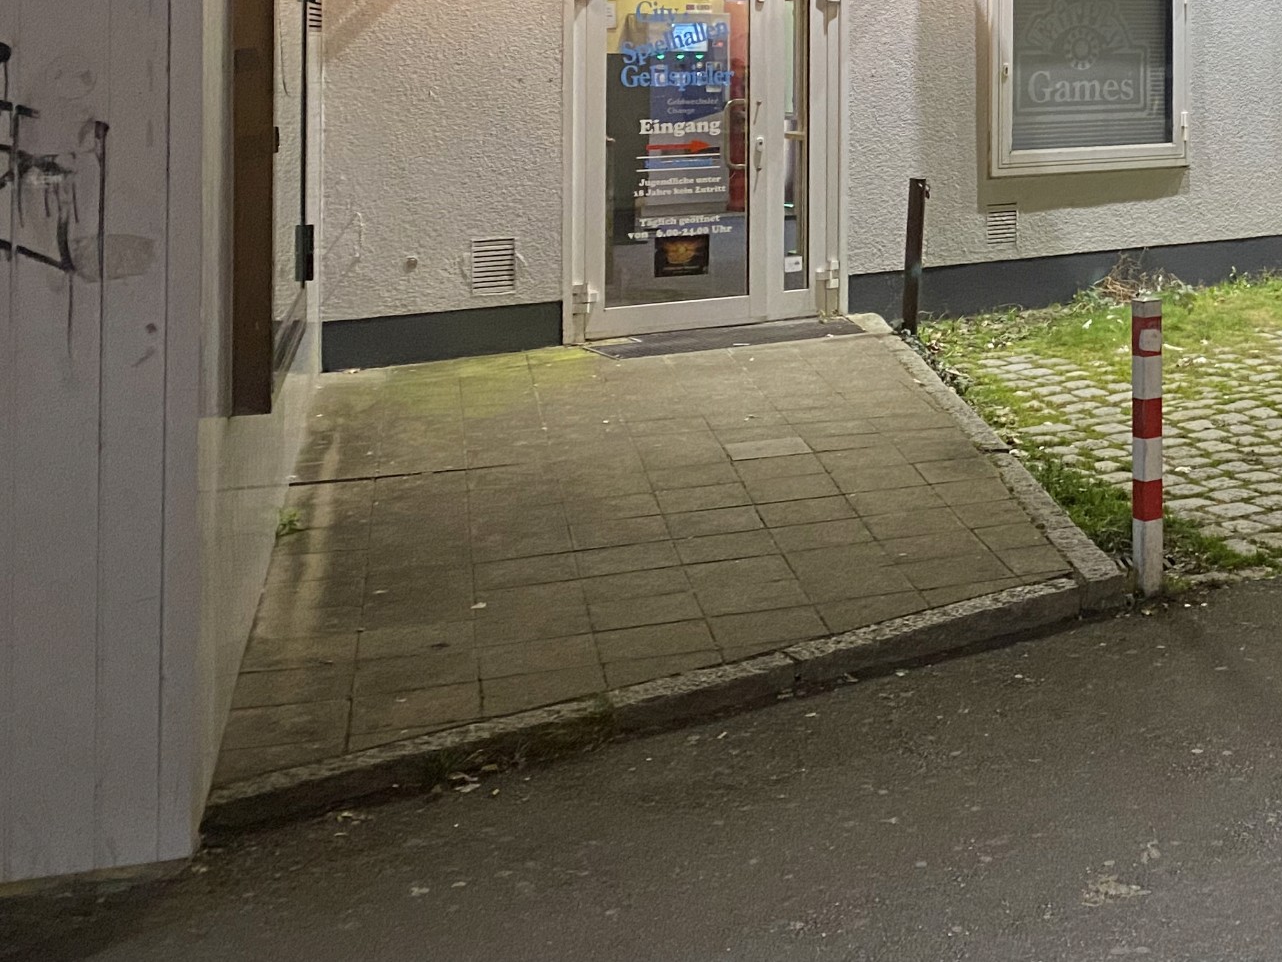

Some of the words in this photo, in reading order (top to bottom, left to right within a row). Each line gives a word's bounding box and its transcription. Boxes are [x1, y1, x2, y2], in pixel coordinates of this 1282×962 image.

[620, 21, 728, 65] Spielhallen
[620, 65, 735, 92] Geldspieler
[1027, 70, 1135, 103] Games
[639, 119, 722, 137] Eingang
[638, 177, 694, 188] Jugendliche
[696, 176, 722, 184] unter
[645, 188, 672, 196] Jahre
[695, 185, 727, 193] Zutritt
[639, 216, 677, 228] Täglich
[679, 214, 721, 226] geöffnet
[711, 225, 733, 233] Uhr
